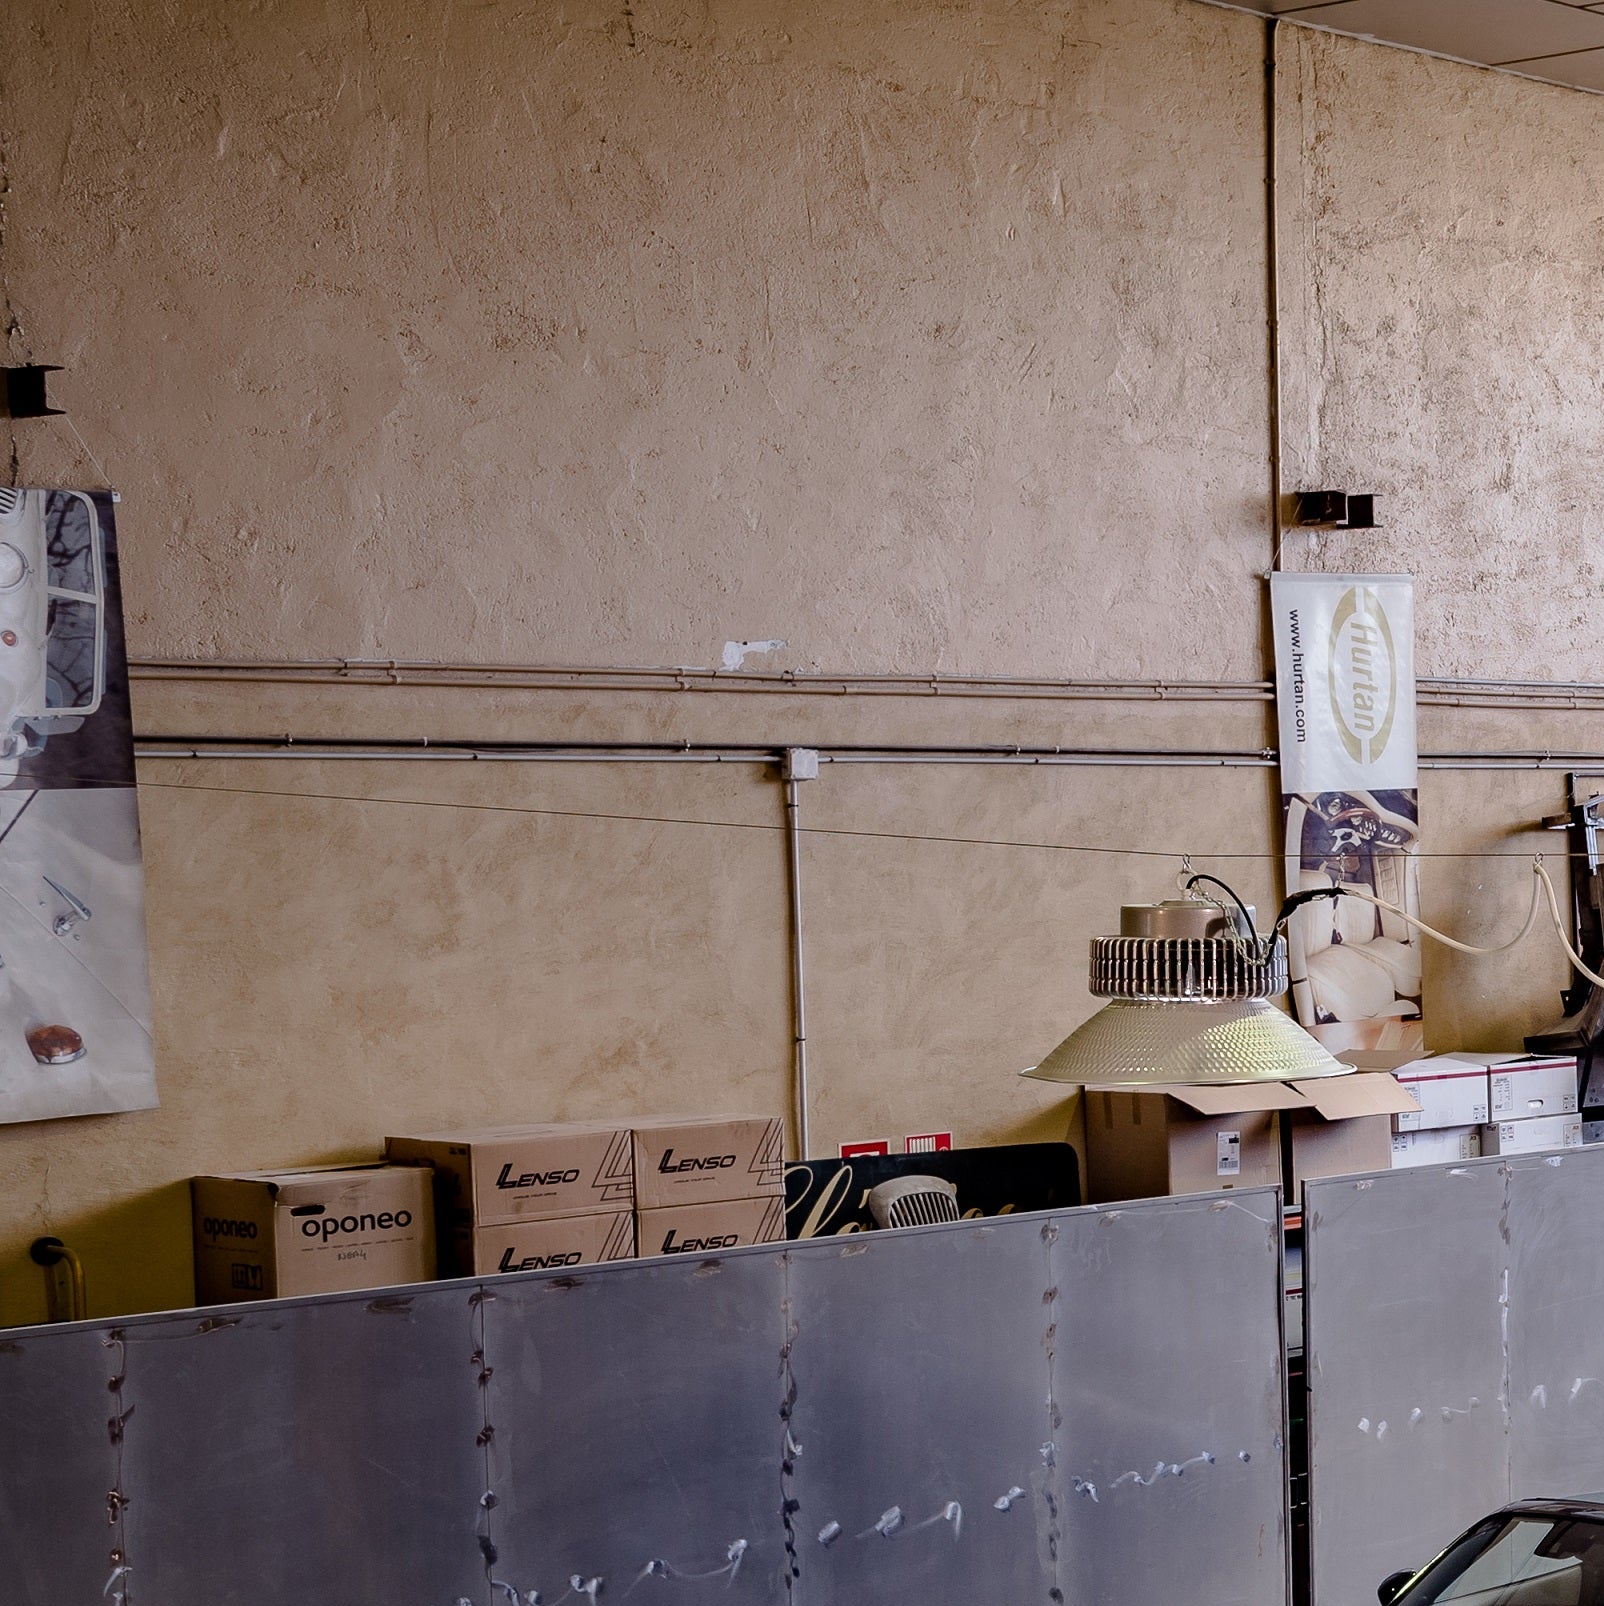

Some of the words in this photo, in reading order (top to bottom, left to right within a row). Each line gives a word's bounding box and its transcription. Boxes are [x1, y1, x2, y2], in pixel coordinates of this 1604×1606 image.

[1289, 609, 1306, 742] www.hurtan.com
[1351, 622, 1379, 732] Hurtan
[659, 1149, 736, 1174] LENSO
[496, 1163, 579, 1189] LENSO
[203, 1217, 258, 1241] oponeo
[302, 1210, 412, 1242] oponeo
[661, 1229, 738, 1254] LENSO
[498, 1247, 582, 1273] LENSO
